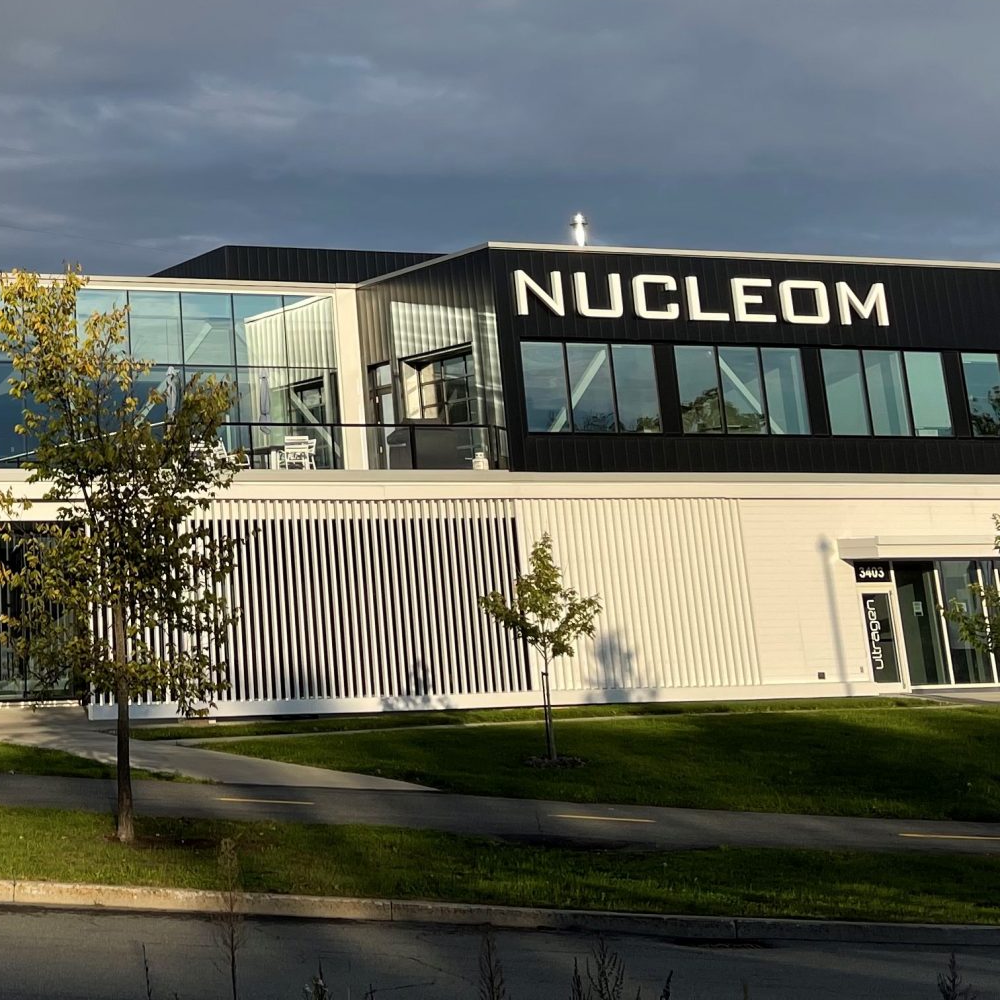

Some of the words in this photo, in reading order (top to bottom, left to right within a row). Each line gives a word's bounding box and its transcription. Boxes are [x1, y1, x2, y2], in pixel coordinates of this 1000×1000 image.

[513, 269, 890, 326] NUCLEOM
[859, 566, 884, 578] 3403
[866, 600, 884, 670] ultragen
